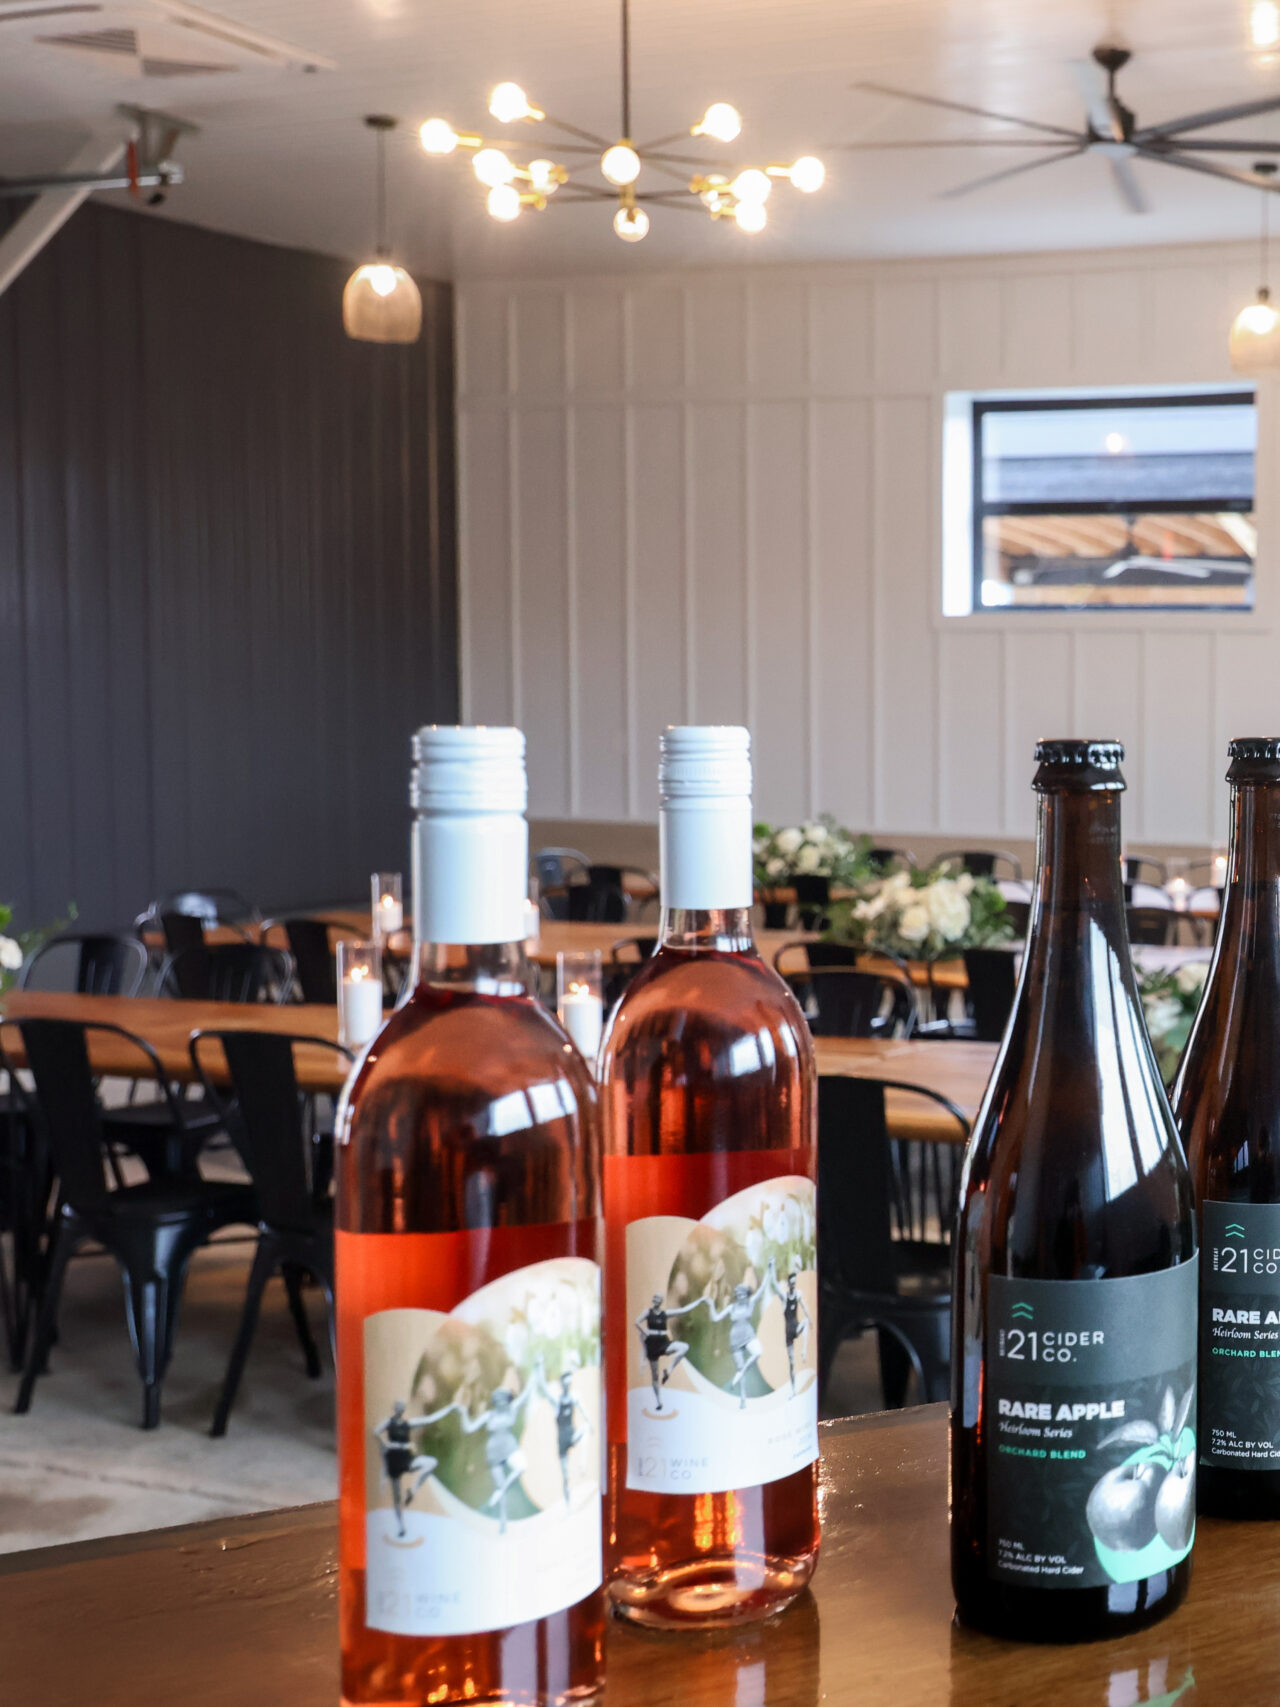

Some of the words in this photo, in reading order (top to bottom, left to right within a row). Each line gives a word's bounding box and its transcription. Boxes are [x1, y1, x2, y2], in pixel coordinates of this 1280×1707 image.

[1220, 1247, 1248, 1274] 21
[1211, 1307, 1261, 1325] RARE
[1211, 1325, 1251, 1340] Heirloom
[1253, 1330, 1279, 1340] Series
[1007, 1329, 1038, 1361] 21
[1042, 1330, 1105, 1347] CIDER
[1211, 1347, 1256, 1358] ORCHARD
[1042, 1347, 1078, 1363] CO.
[998, 1399, 1053, 1421] RARE
[1055, 1399, 1126, 1421] APPLE
[998, 1421, 1042, 1438] Heirloom
[1043, 1426, 1073, 1439] Series
[998, 1444, 1047, 1458] ORCHARD
[1049, 1449, 1087, 1460] BLEND
[1212, 1448, 1249, 1457] Carbonated
[671, 1457, 708, 1466] WINE
[1016, 1553, 1032, 1562] ALC
[1048, 1555, 1066, 1564] VOL
[1041, 1566, 1060, 1574] Hard
[1062, 1566, 1084, 1575] Cider
